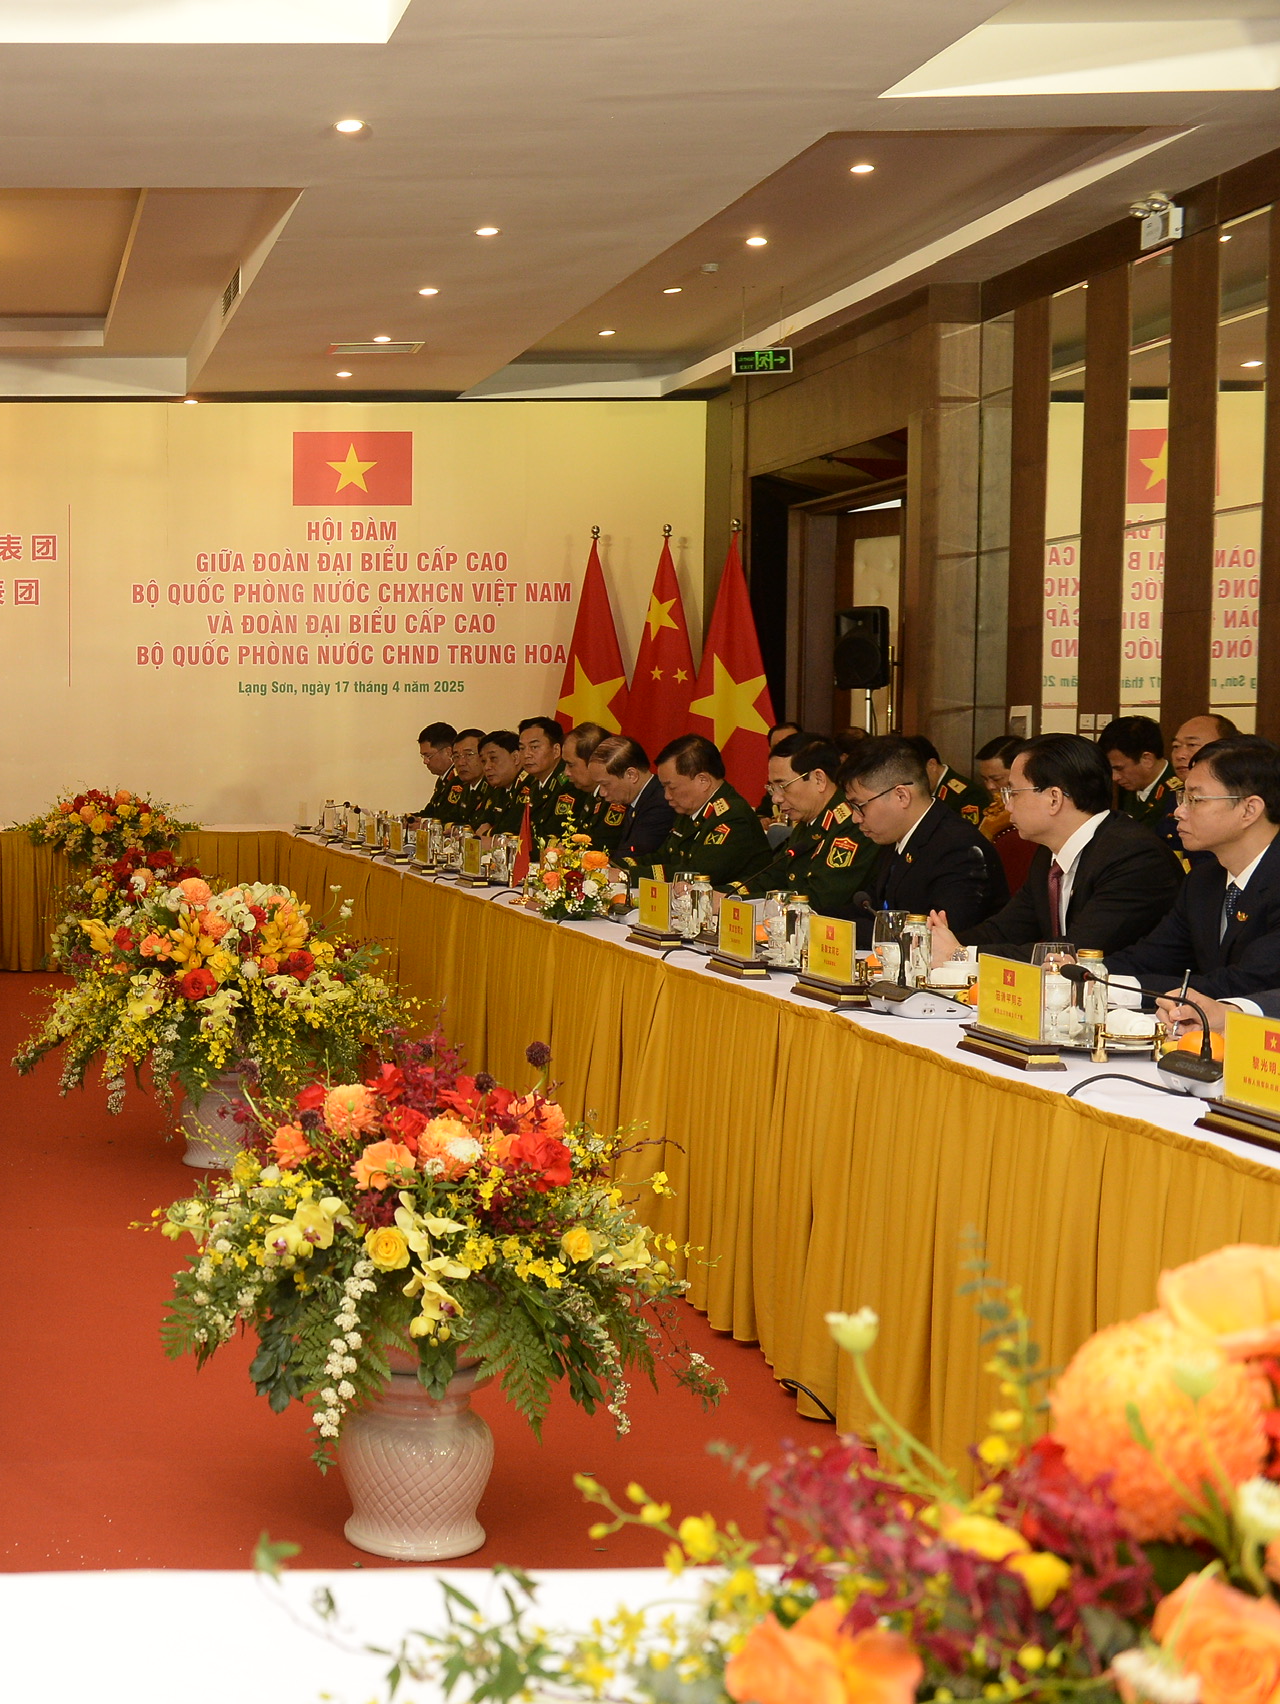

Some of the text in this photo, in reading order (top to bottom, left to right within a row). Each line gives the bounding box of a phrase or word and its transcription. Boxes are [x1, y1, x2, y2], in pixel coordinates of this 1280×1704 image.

[307, 516, 397, 545] HỘI ĐÀM
[196, 544, 508, 576] GIỮA ĐOÀN ĐẠI BIỂU CẤP CAO
[132, 577, 572, 608] BỘ QUỐC PHÒNG NƯỚC CHXHCN VIỆT NAM
[207, 607, 497, 638] VÀ ĐOÀN ĐẠI BIỂU CẤP CAO
[137, 639, 567, 670] BỘ QUỐC PHÒNG NƯỚC CHND TRUNG HOA
[238, 680, 465, 697] Lạng Sơn, ngày 17 tháng 4 năm 2025
